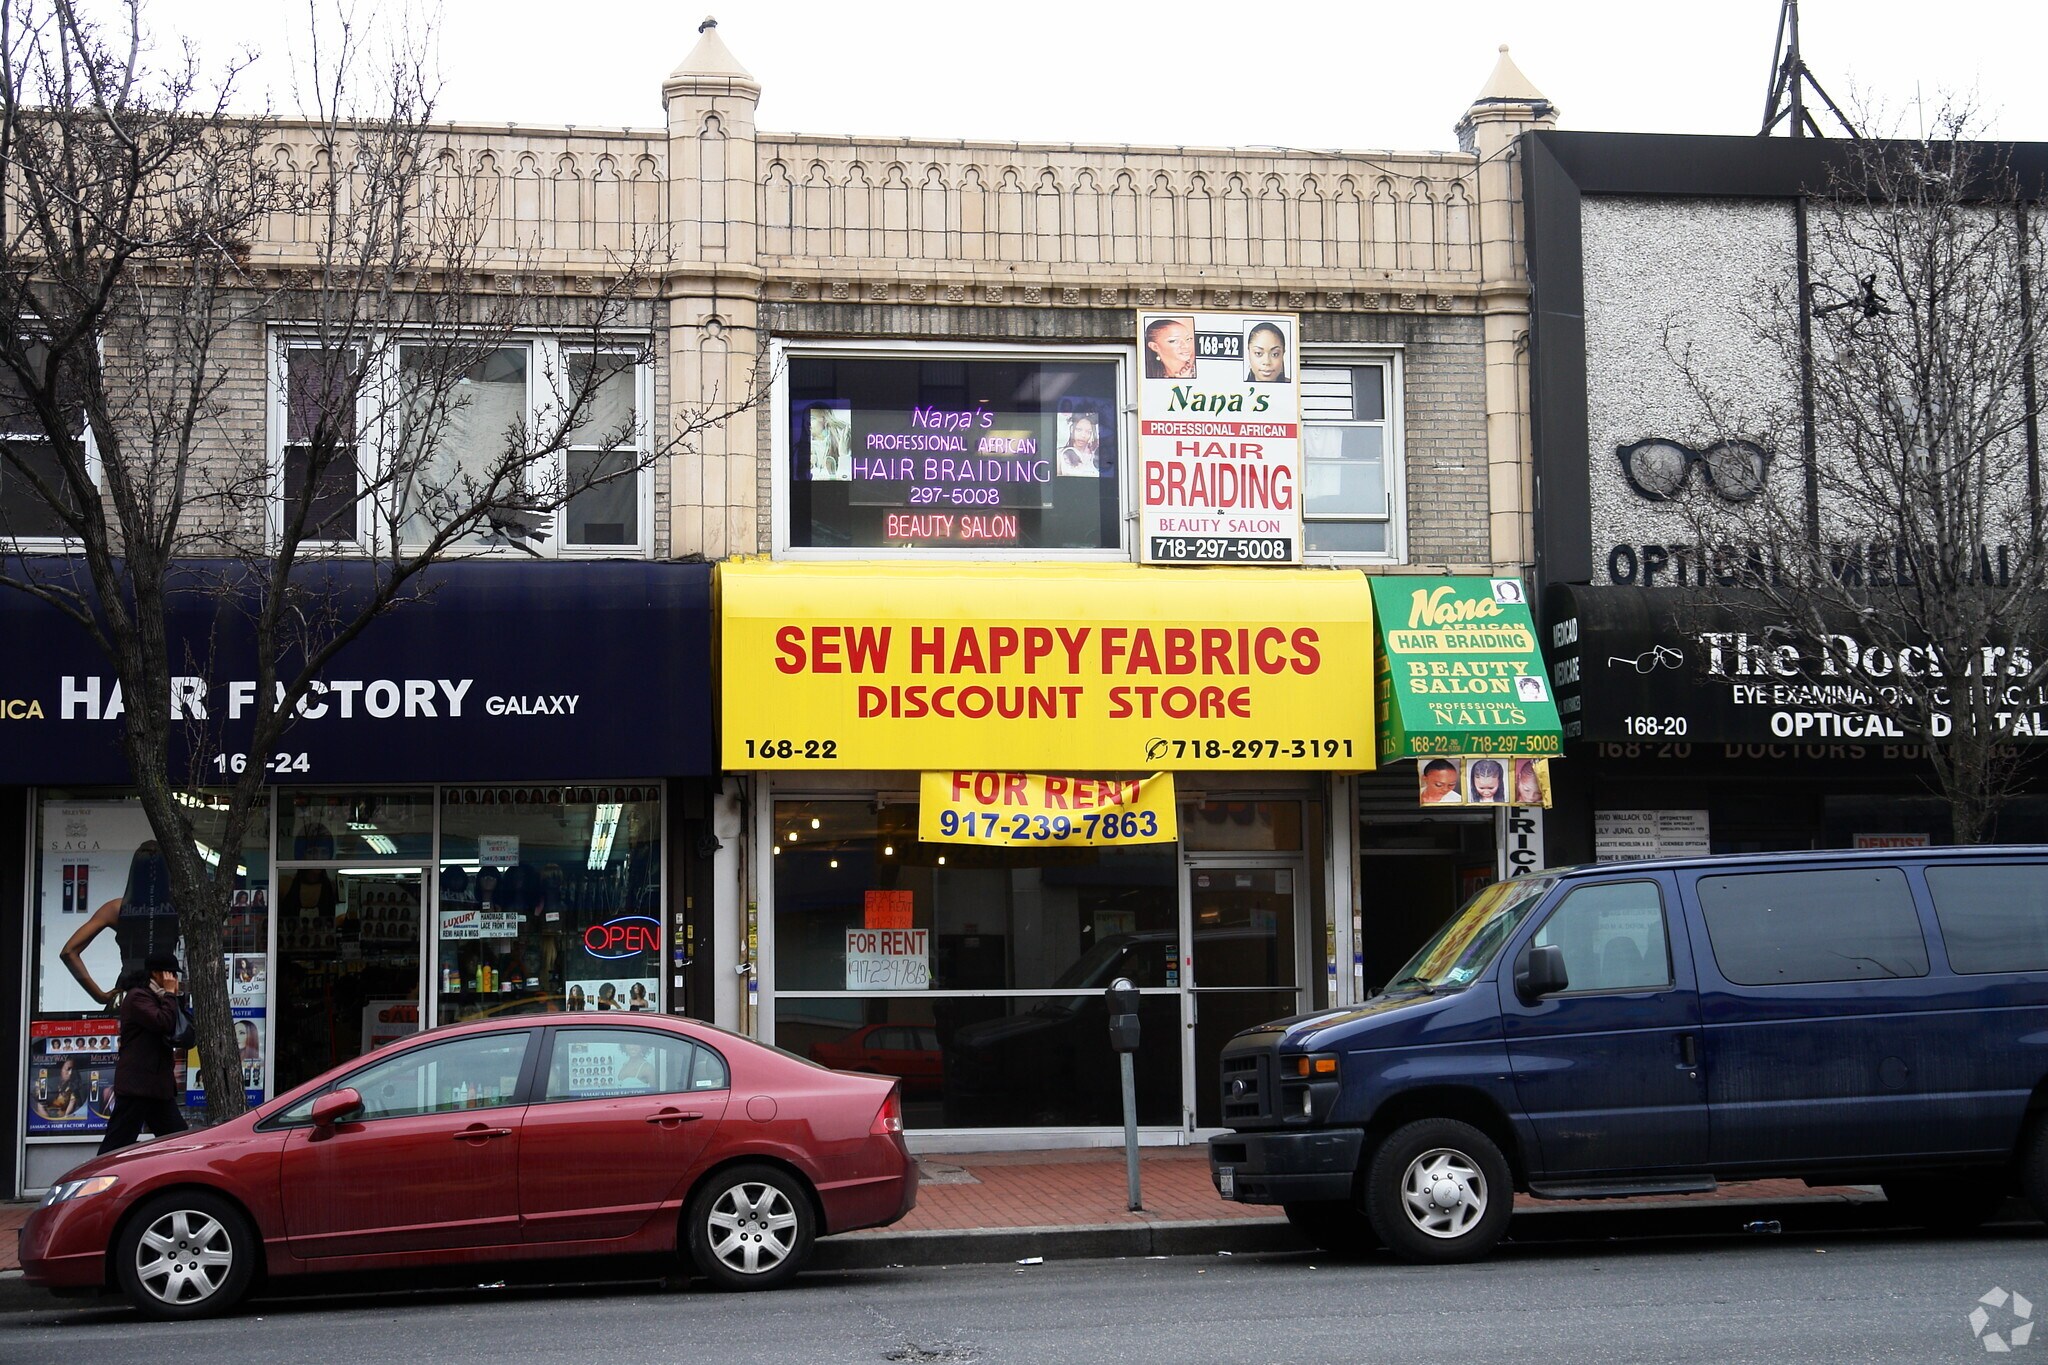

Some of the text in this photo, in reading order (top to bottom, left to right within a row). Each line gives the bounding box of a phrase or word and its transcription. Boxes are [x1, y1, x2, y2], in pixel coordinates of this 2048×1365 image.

[1199, 336, 1239, 356] 168-22
[1167, 385, 1270, 416] Nana's
[911, 406, 994, 432] Nana's
[1151, 422, 1286, 437] PROFESSIONAL AFRICAN
[866, 434, 1036, 454] PROFESSIONAL AFRICAN
[1176, 441, 1263, 459] HAIR
[852, 457, 1051, 483] HAIR BRAIDING
[1145, 460, 1293, 510] BRAIDING
[909, 486, 1000, 505] 297-5008
[888, 513, 1017, 539] BEAUTY SALON
[1159, 518, 1280, 533] BEAUTY SALON
[1156, 539, 1285, 559] 718-297-5008
[1408, 585, 1505, 629] Nana
[1441, 623, 1526, 631] AFRICAN
[1552, 617, 1578, 648] MEDICAID
[775, 625, 1321, 676] SEW HAPPY FABRICS
[1397, 634, 1526, 649] HAIR BRAIDING
[1698, 632, 2033, 678] The Doctrs
[1407, 661, 1529, 677] BEAUTY
[1553, 656, 1580, 687] MEDICARE
[1410, 678, 1511, 694] SALON
[1733, 684, 1767, 704] EYE
[485, 695, 580, 716] GALAXY
[858, 685, 1250, 719] DISCOUNT STORE
[1429, 702, 1518, 710] PROFESSIONAL
[1435, 709, 1527, 726] NAILS
[1624, 716, 1687, 736] 168-20
[1770, 712, 1904, 738] OPTICAL
[745, 739, 838, 760] 168-22
[1171, 739, 1353, 760] 718-297-3191
[1410, 736, 1448, 753] 168-22
[1471, 735, 1559, 753] 718-297-5008
[1725, 742, 1868, 760] DOCTORS
[213, 751, 311, 774] 16-24
[951, 771, 1142, 810] FOR RENT
[939, 809, 1158, 841] 917-239-7863
[51, 841, 101, 851] SAGA
[1857, 837, 1927, 849] DENTIST
[443, 911, 476, 929] LUXURY
[480, 912, 517, 920] HANDMADE WIGS
[480, 922, 517, 930] LACE FRONT WIGS
[585, 925, 661, 951] OPEN
[848, 931, 927, 955] FOR RENT
[241, 983, 260, 993] Sale
